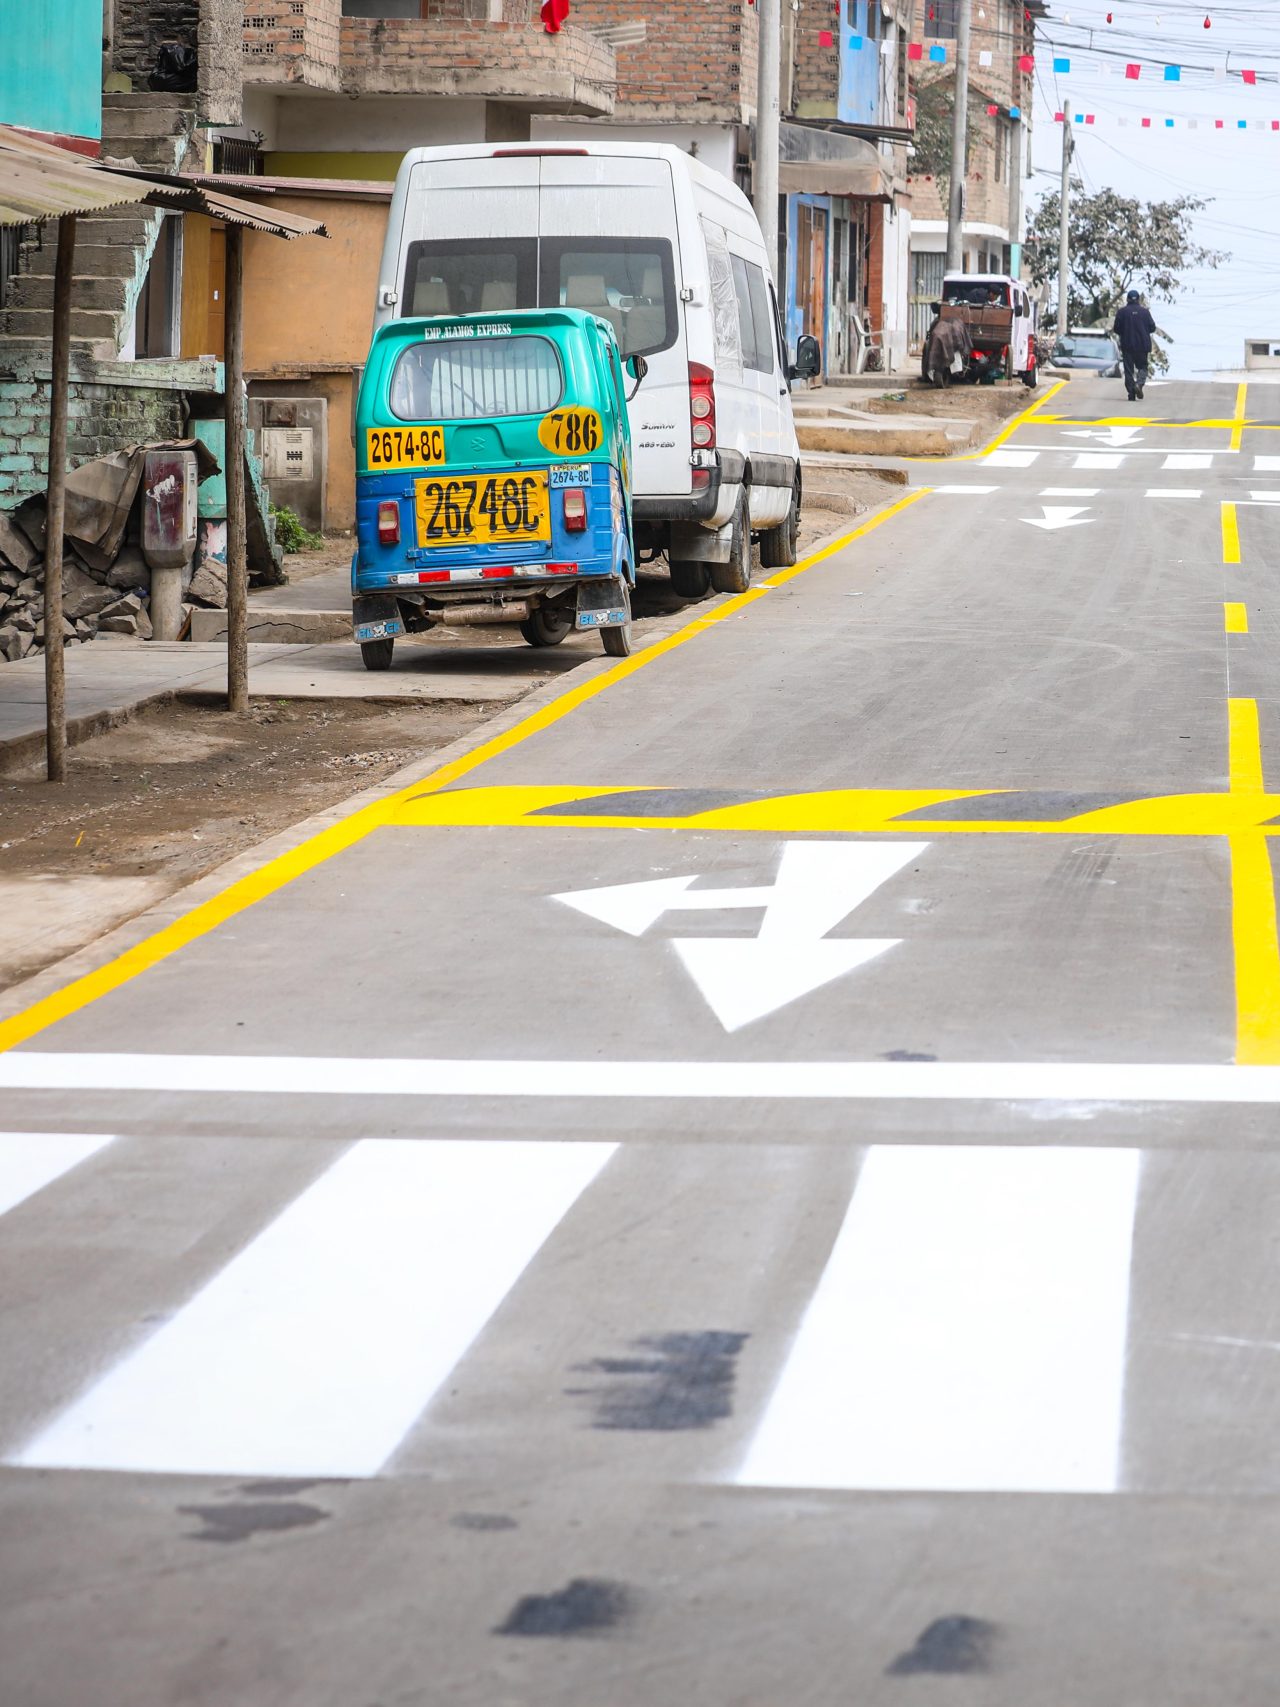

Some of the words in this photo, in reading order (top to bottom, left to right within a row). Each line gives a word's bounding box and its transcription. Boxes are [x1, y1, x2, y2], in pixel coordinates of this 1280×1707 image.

[477, 323, 512, 336] EXPRESS
[551, 413, 598, 452] 786
[371, 430, 442, 463] 2674-8C
[553, 471, 589, 483] 2674-8C
